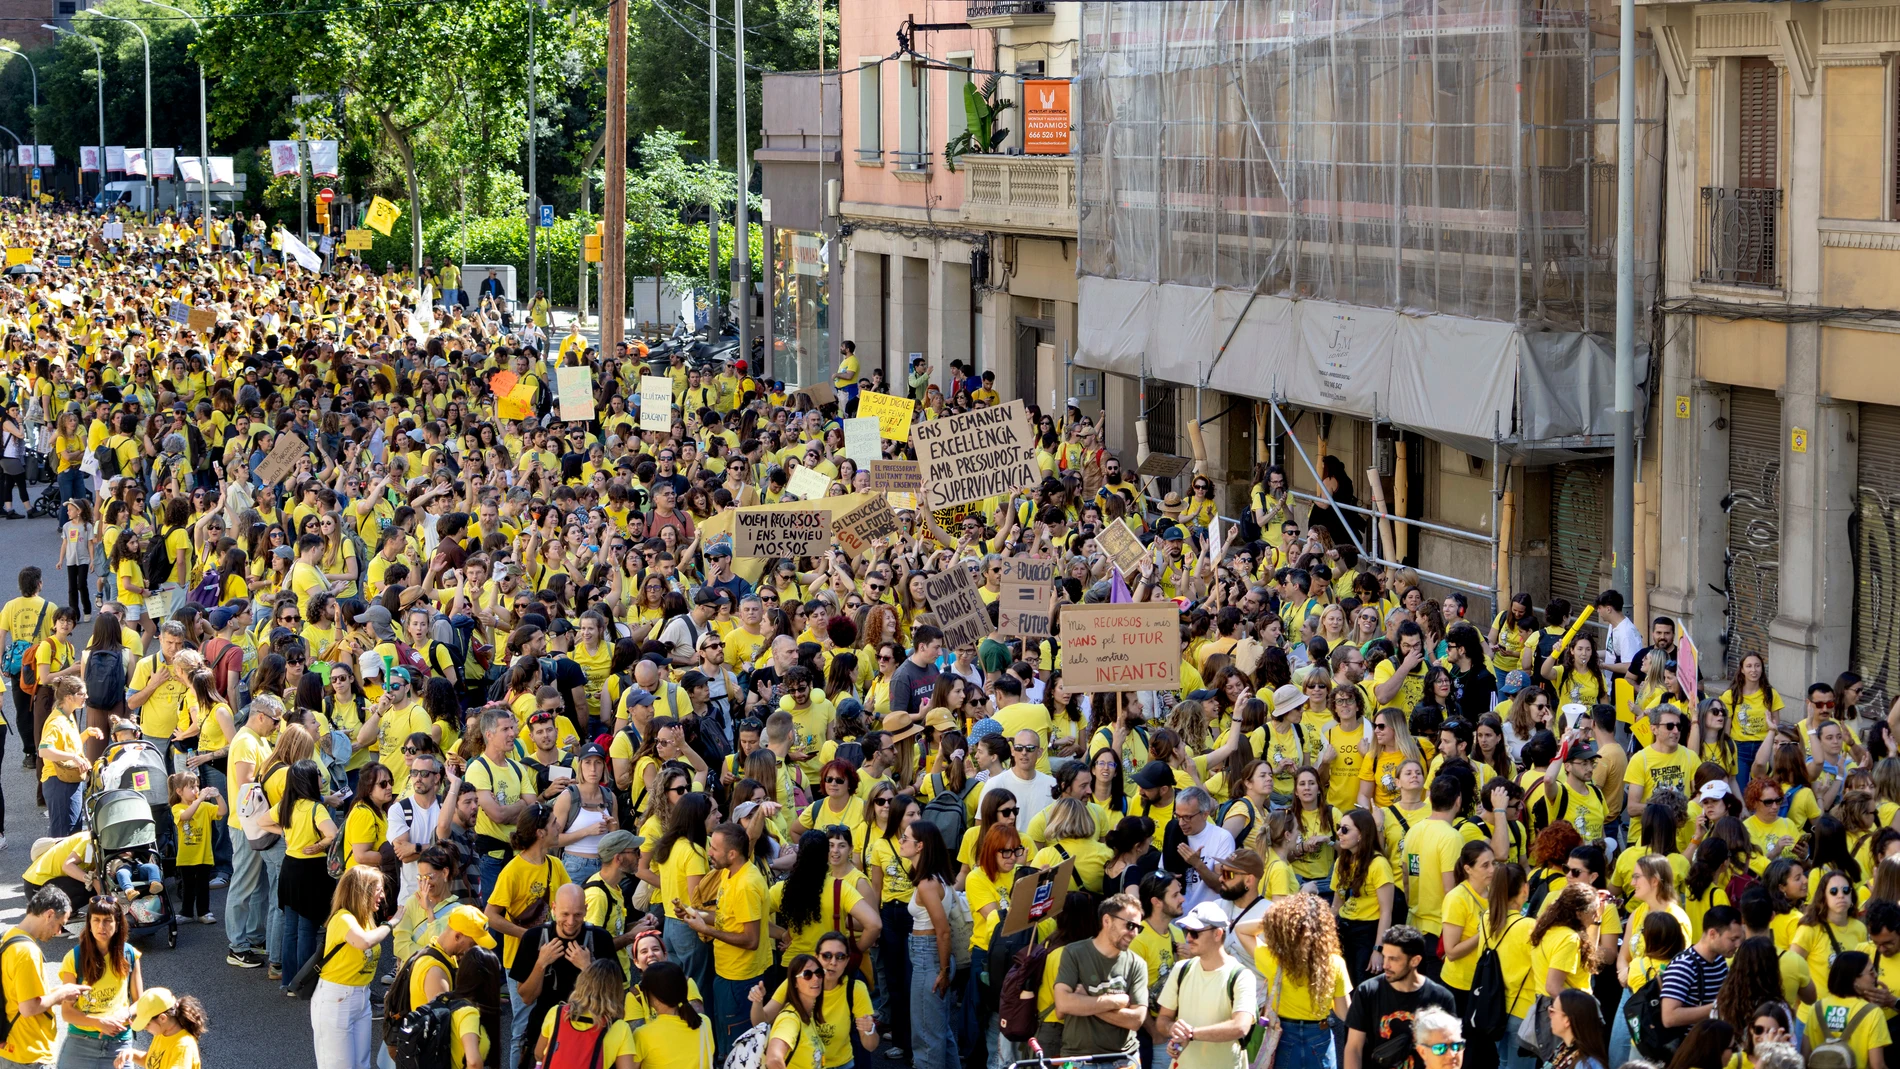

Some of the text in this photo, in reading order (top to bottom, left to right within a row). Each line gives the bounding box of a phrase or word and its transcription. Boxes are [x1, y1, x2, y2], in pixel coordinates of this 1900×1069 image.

[377, 202, 392, 214] SOS
[544, 208, 550, 217] P
[872, 394, 888, 406] SOU
[890, 397, 911, 410] DIGNE
[641, 412, 668, 422] EDUCANT
[917, 405, 1012, 440] ENS DEMANEN
[271, 450, 279, 460] DE
[930, 446, 1035, 482] AMB PRESSUPOST DE
[932, 464, 1035, 506] SUPERVIVÈNCIA
[738, 512, 820, 529] VOLEM RECURSOS
[831, 521, 842, 533] SI
[756, 529, 776, 541] ENS
[783, 529, 823, 541] ENVIEU
[837, 508, 896, 550] CAU EL FUTUR
[753, 542, 808, 556] MOSSOS
[926, 566, 970, 601] CUIDAR QUI
[935, 591, 972, 626] EDUCA ÉS
[1018, 613, 1049, 634] FUTUR
[1093, 616, 1142, 628] RECURSOS
[943, 618, 980, 652] CUIDAR QUI
[1068, 631, 1164, 649] MANS pel FUTUR
[1068, 652, 1129, 664] dels nostres
[1340, 745, 1359, 753] SOS
[1650, 765, 1681, 778] REASON
[1828, 1006, 1847, 1017] JO
